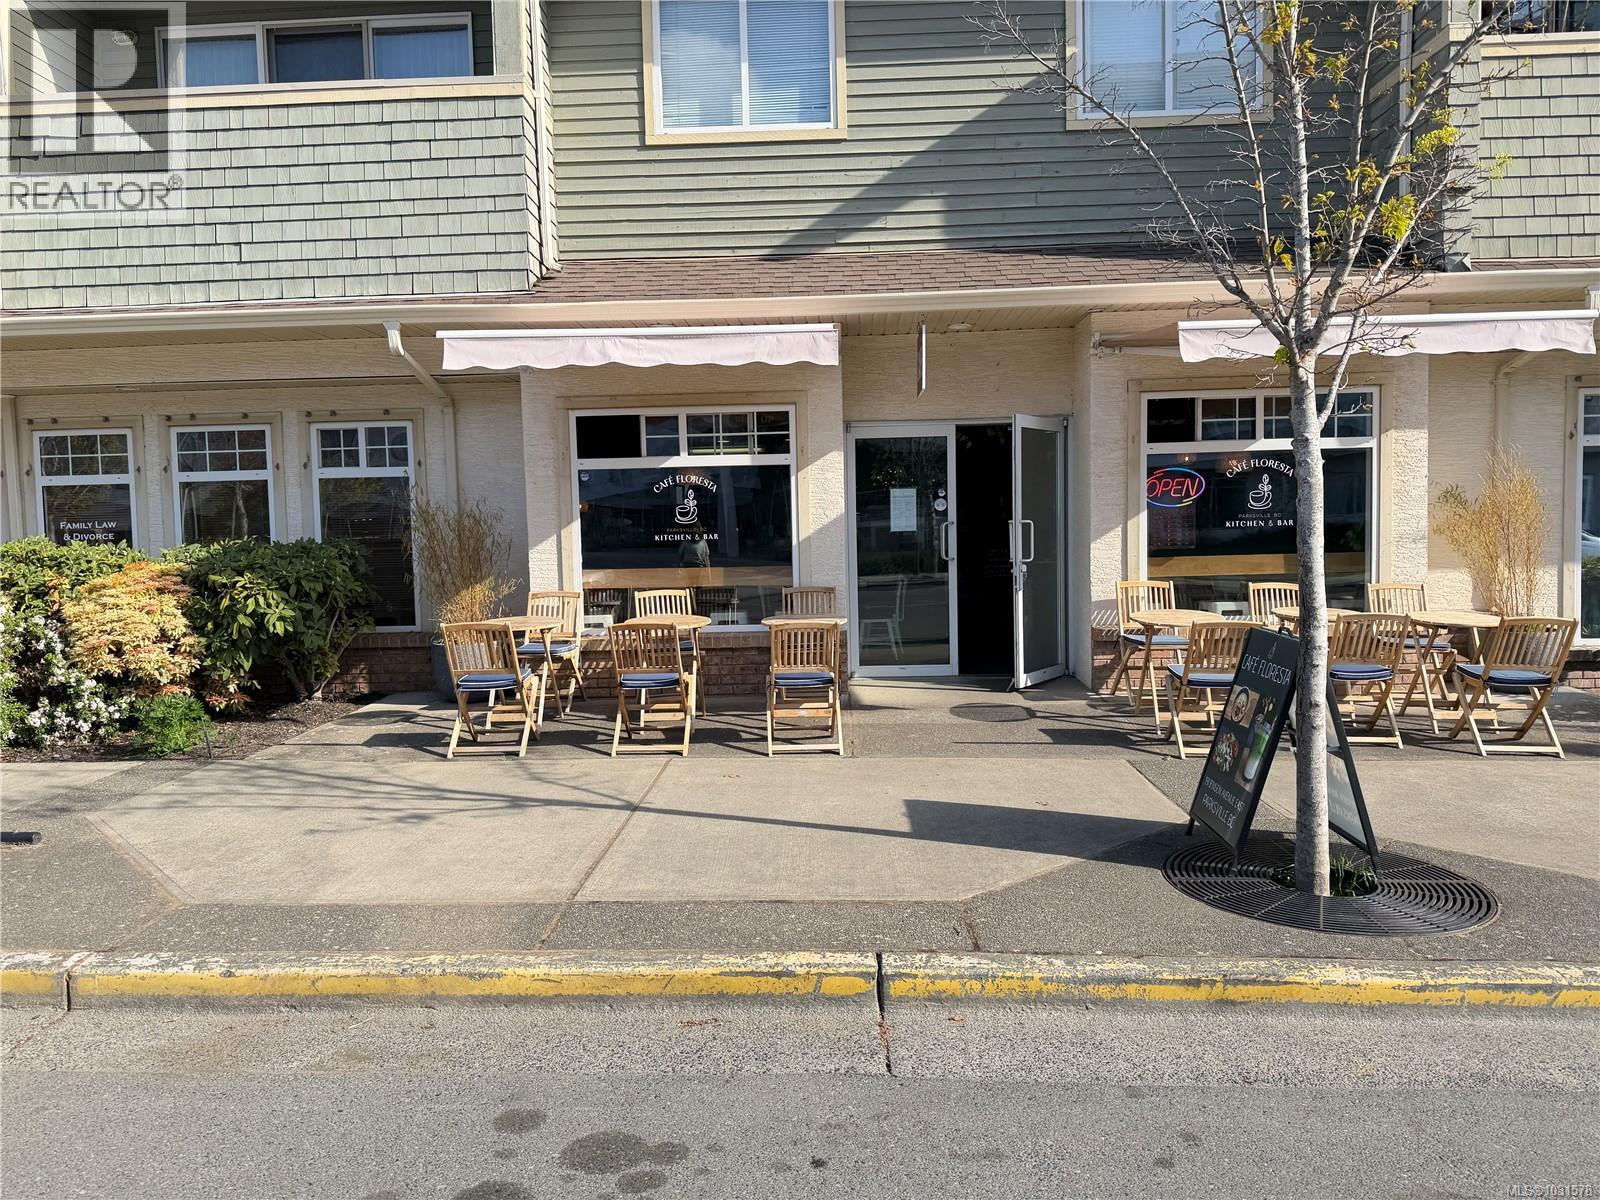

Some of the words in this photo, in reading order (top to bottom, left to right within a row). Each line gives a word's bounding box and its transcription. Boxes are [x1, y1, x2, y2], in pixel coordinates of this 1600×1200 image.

[1226, 459, 1249, 478] CAFÉ
[1250, 458, 1294, 478] FLORESTA
[653, 475, 675, 494] CAFÉ
[676, 474, 717, 493] FLORESTA
[1147, 477, 1199, 497] OPEN
[1225, 520, 1265, 528] KITCHEN
[1257, 659, 1291, 685] FLORESTA
